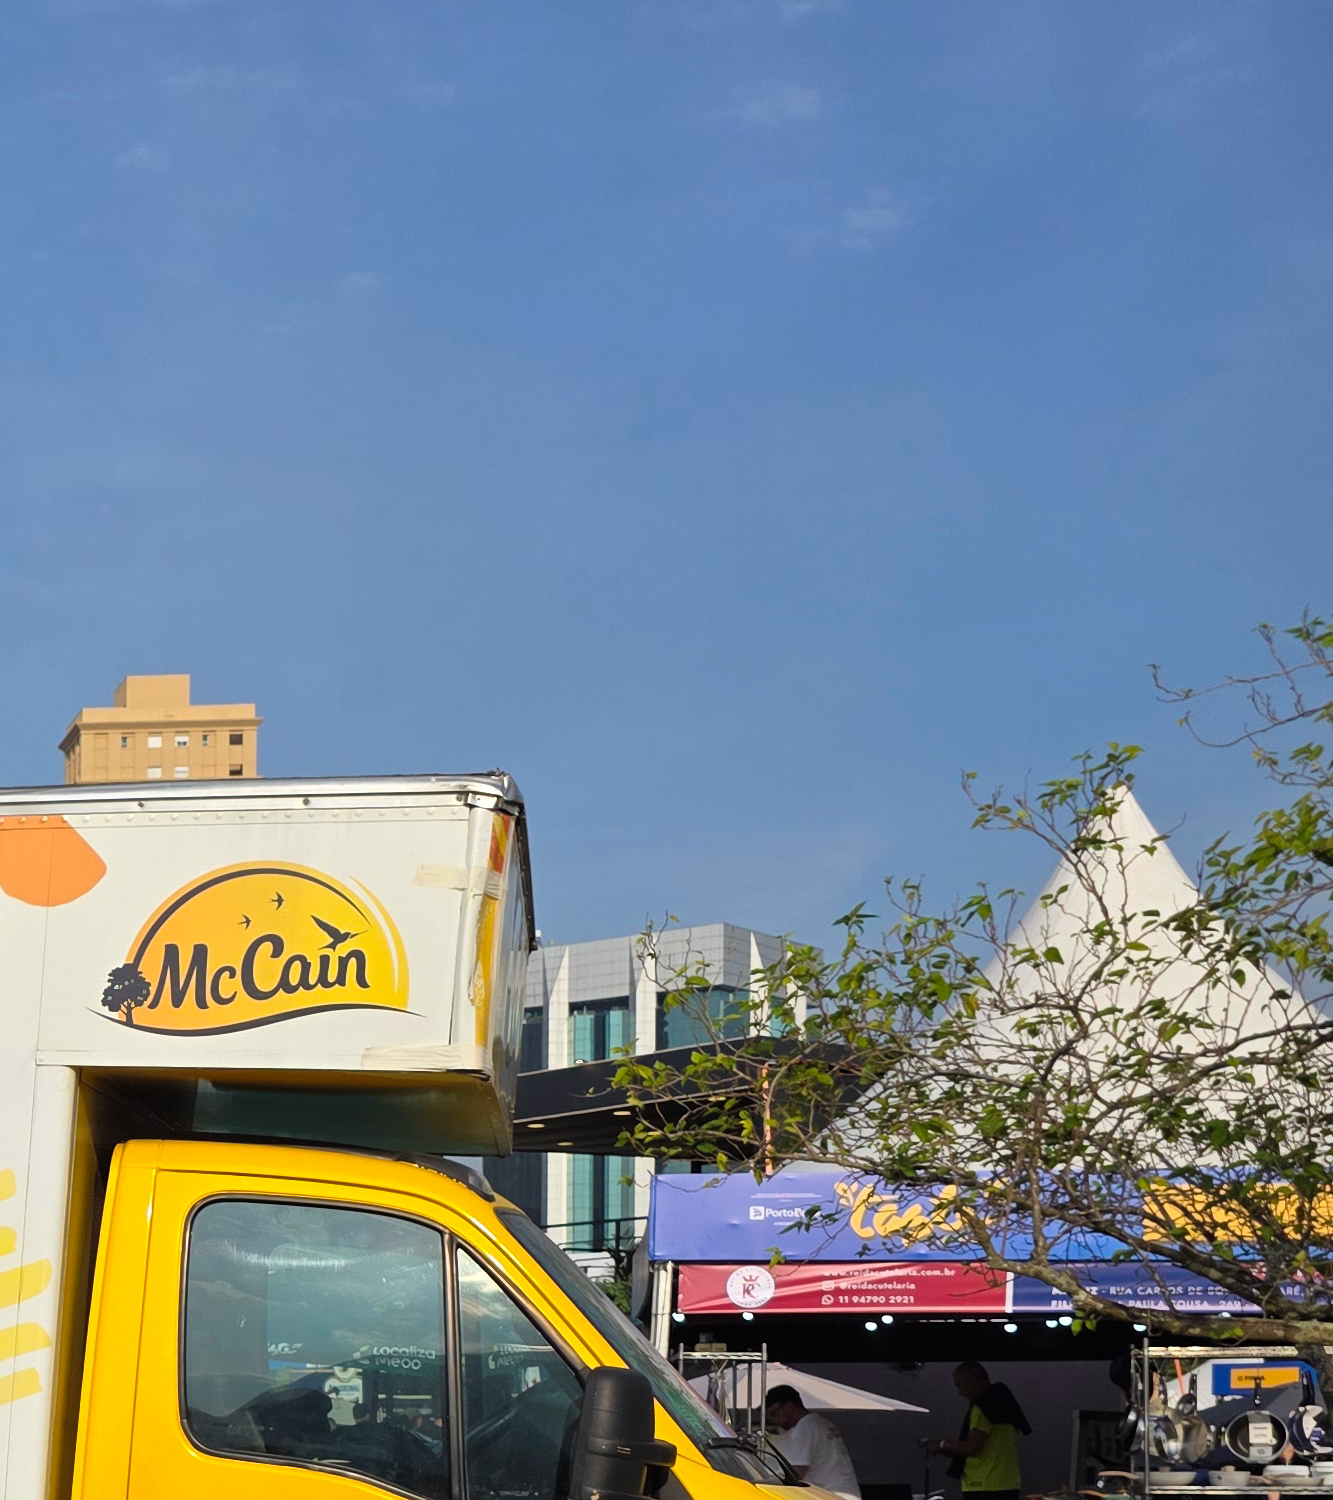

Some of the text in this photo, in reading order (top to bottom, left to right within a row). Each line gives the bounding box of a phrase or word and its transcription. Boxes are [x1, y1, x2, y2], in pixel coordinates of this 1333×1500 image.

[147, 933, 371, 1010] McCain
[1136, 1286, 1183, 1295] CAROS
[838, 1295, 915, 1304] 11 94790 2921
